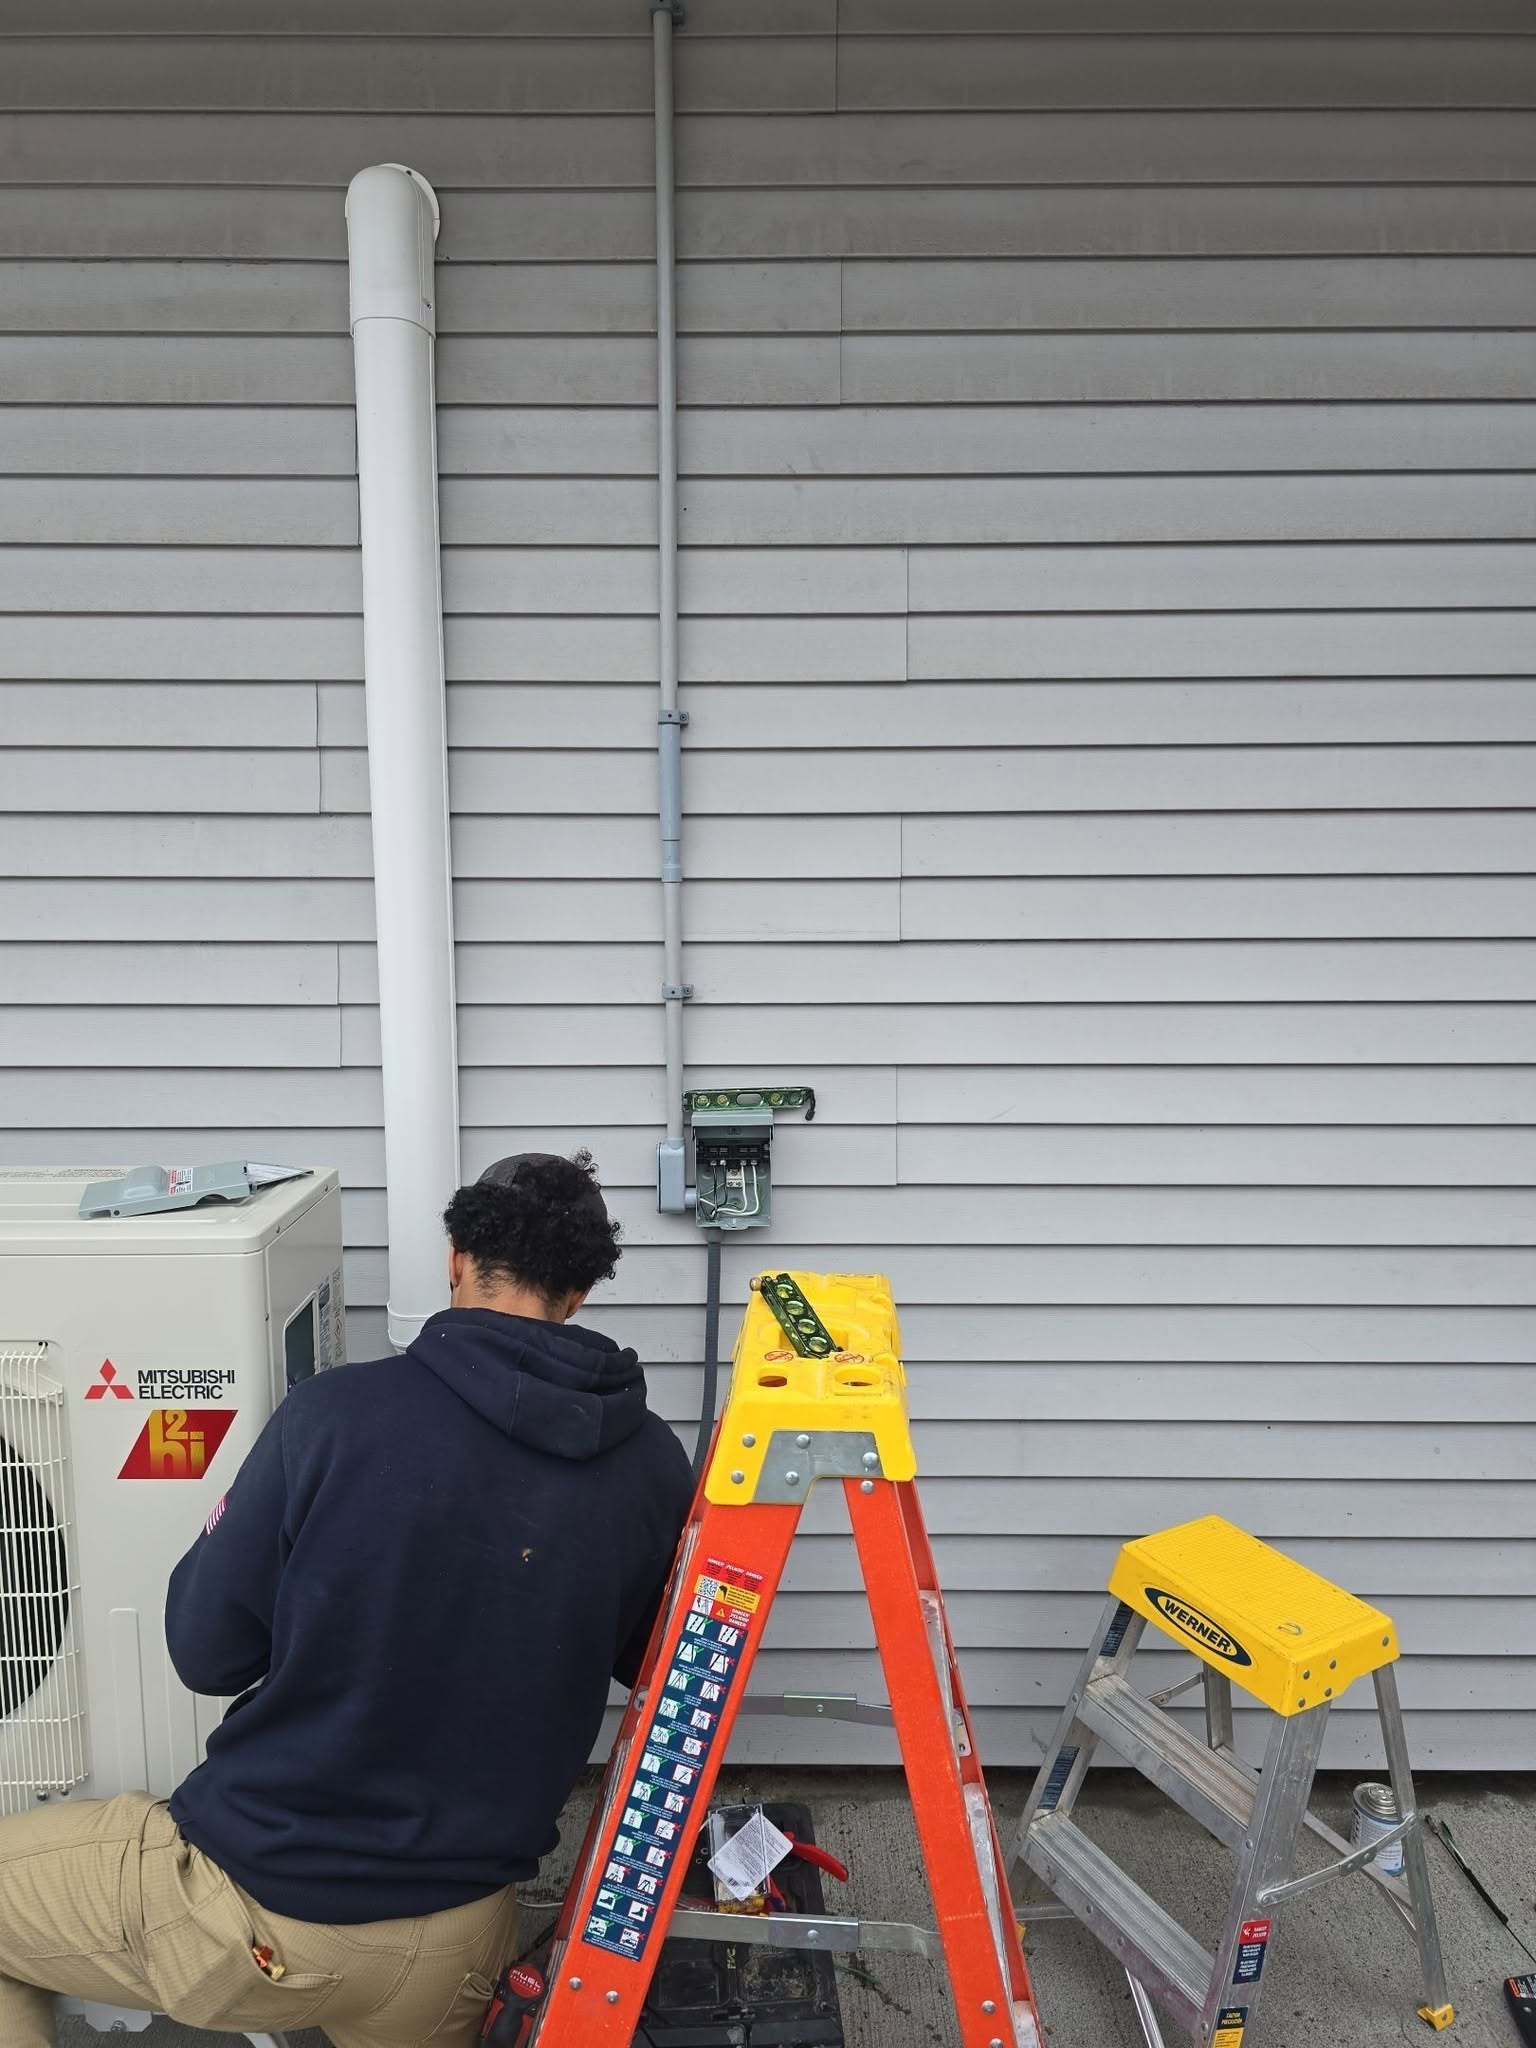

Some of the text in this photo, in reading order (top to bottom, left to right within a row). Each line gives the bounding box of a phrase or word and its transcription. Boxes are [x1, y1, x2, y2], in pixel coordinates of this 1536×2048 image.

[138, 1370, 235, 1384] MITSUBISHI
[139, 1385, 223, 1400] ELECTRIC
[1164, 1599, 1231, 1653] WERNER
